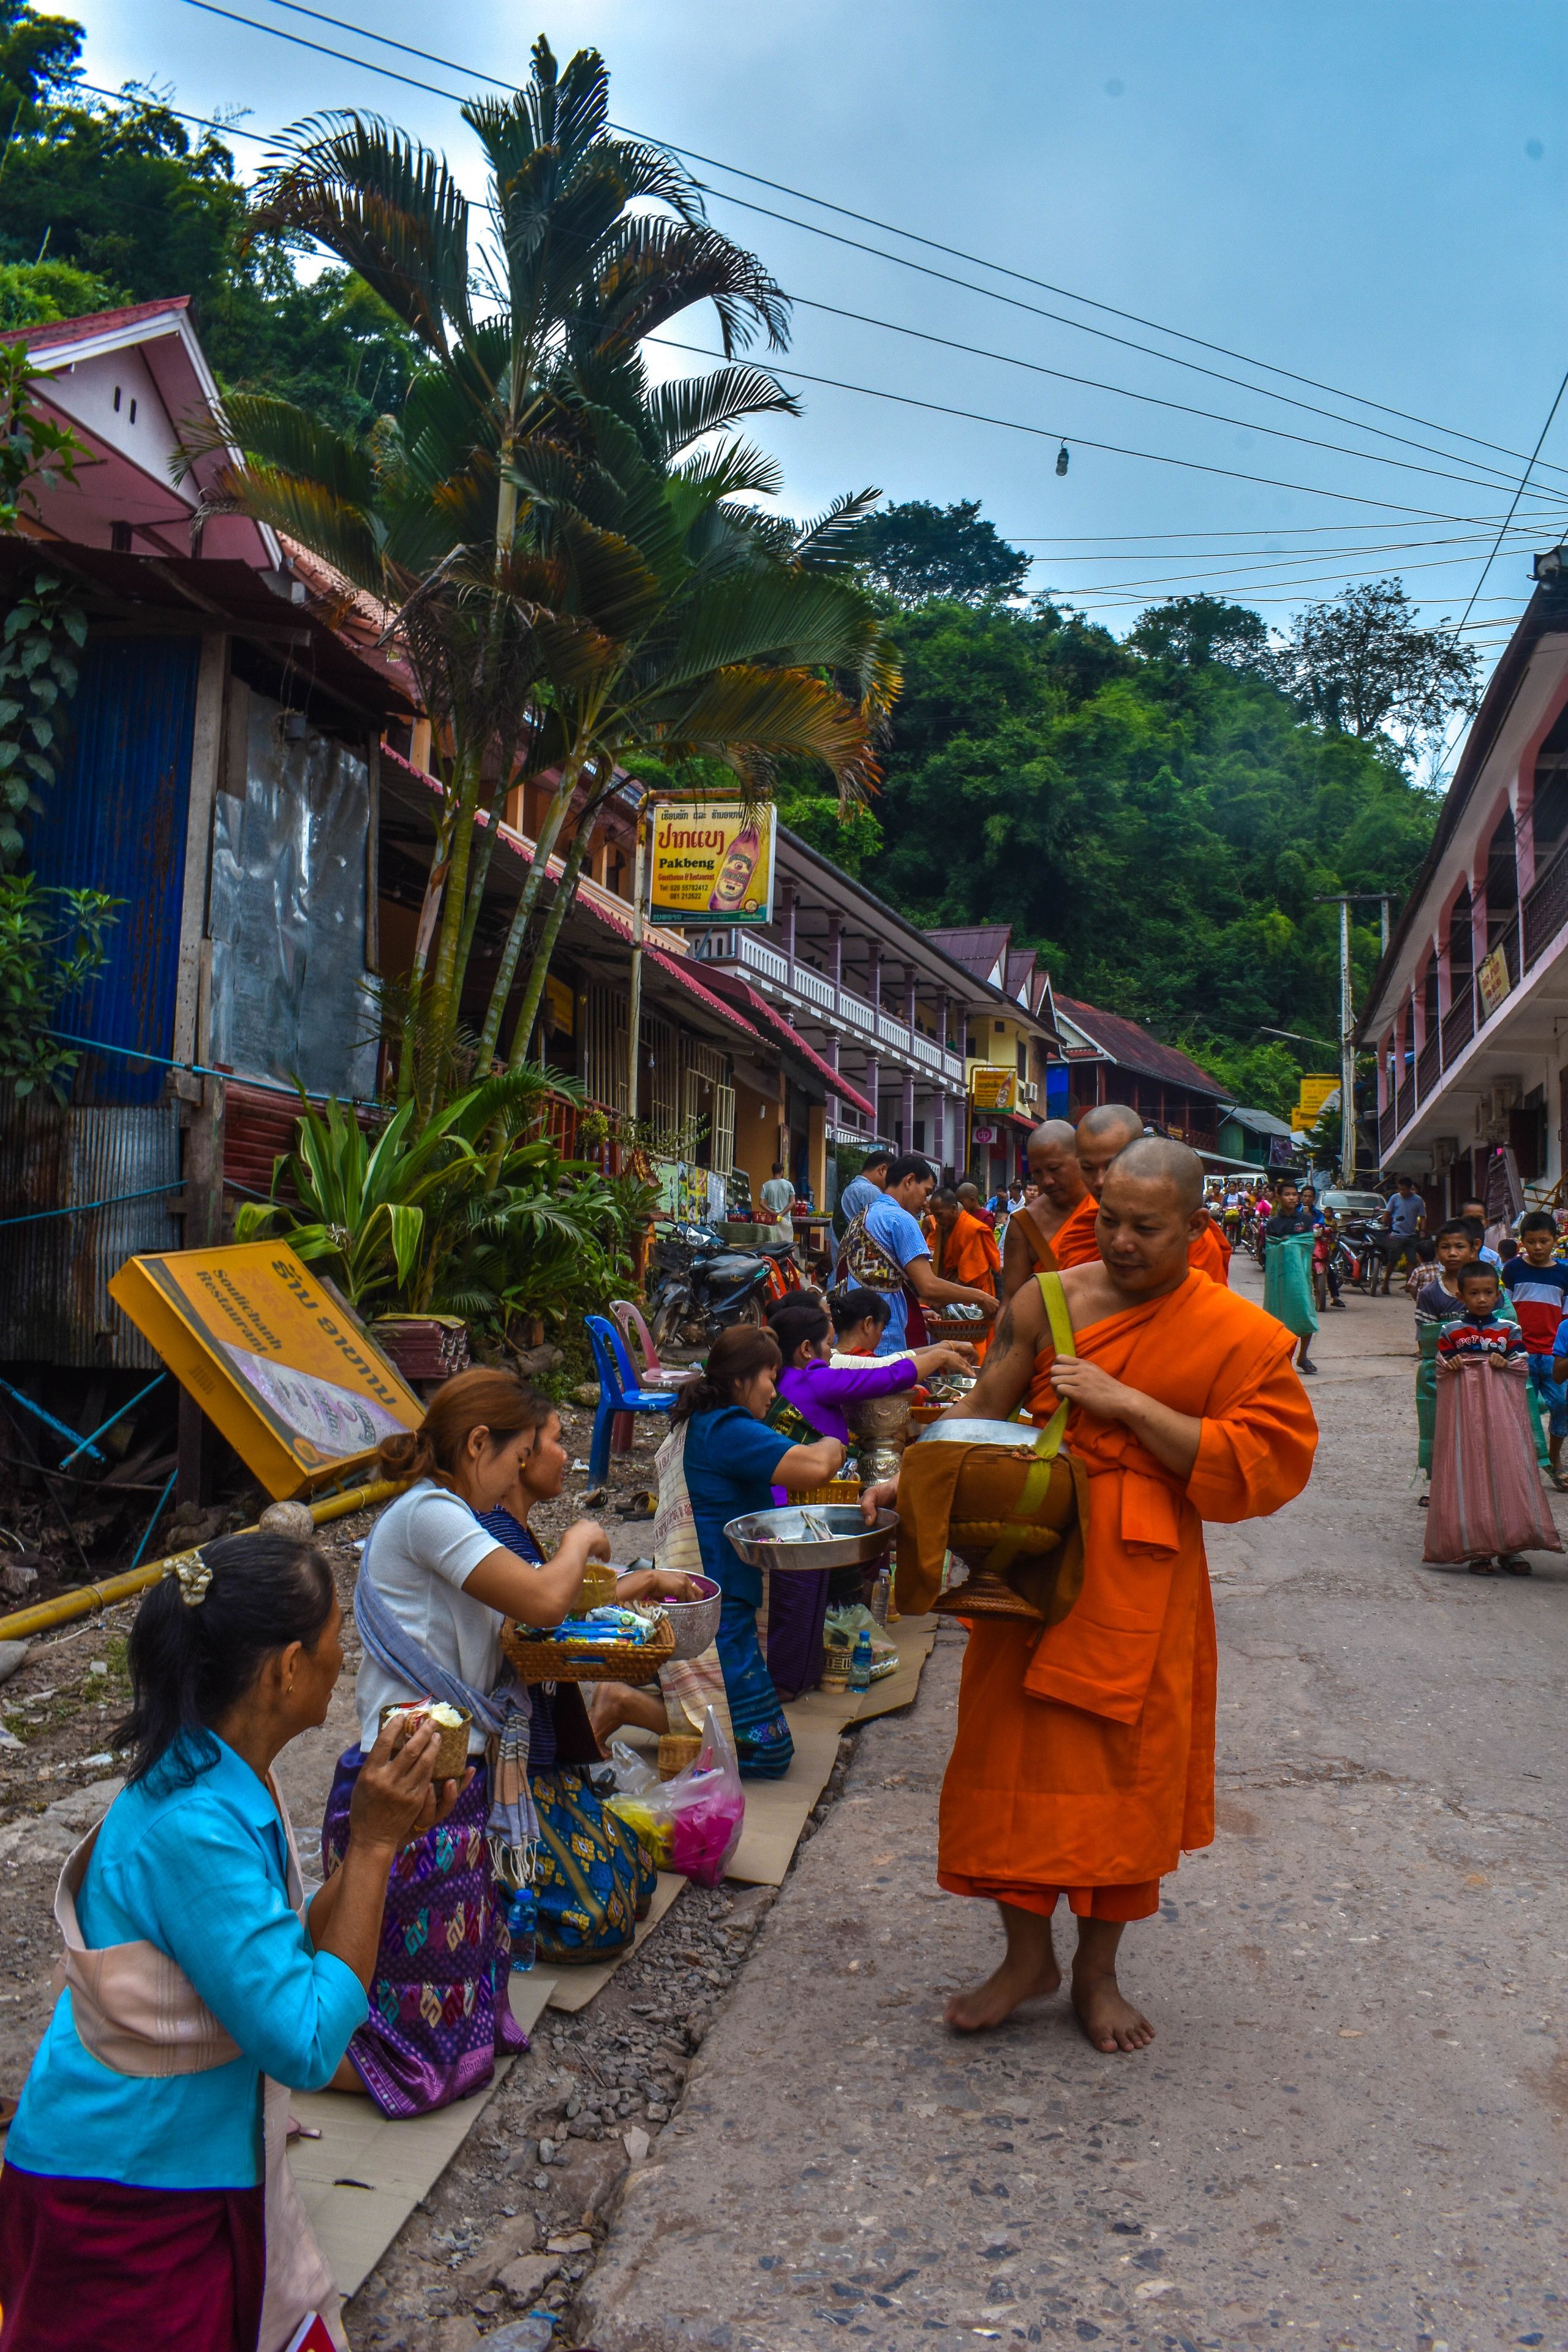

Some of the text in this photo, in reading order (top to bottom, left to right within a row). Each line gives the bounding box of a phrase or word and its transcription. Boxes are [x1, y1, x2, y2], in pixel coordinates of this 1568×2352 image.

[658, 823, 725, 855] ປາກແບງ
[659, 858, 715, 870] Pakbeng
[196, 1272, 268, 1352] Restaurant
[213, 1269, 282, 1349] Soulichanh
[317, 1317, 397, 1404] ອາຫານ
[1455, 1335, 1507, 1352] SPOT Y-3
